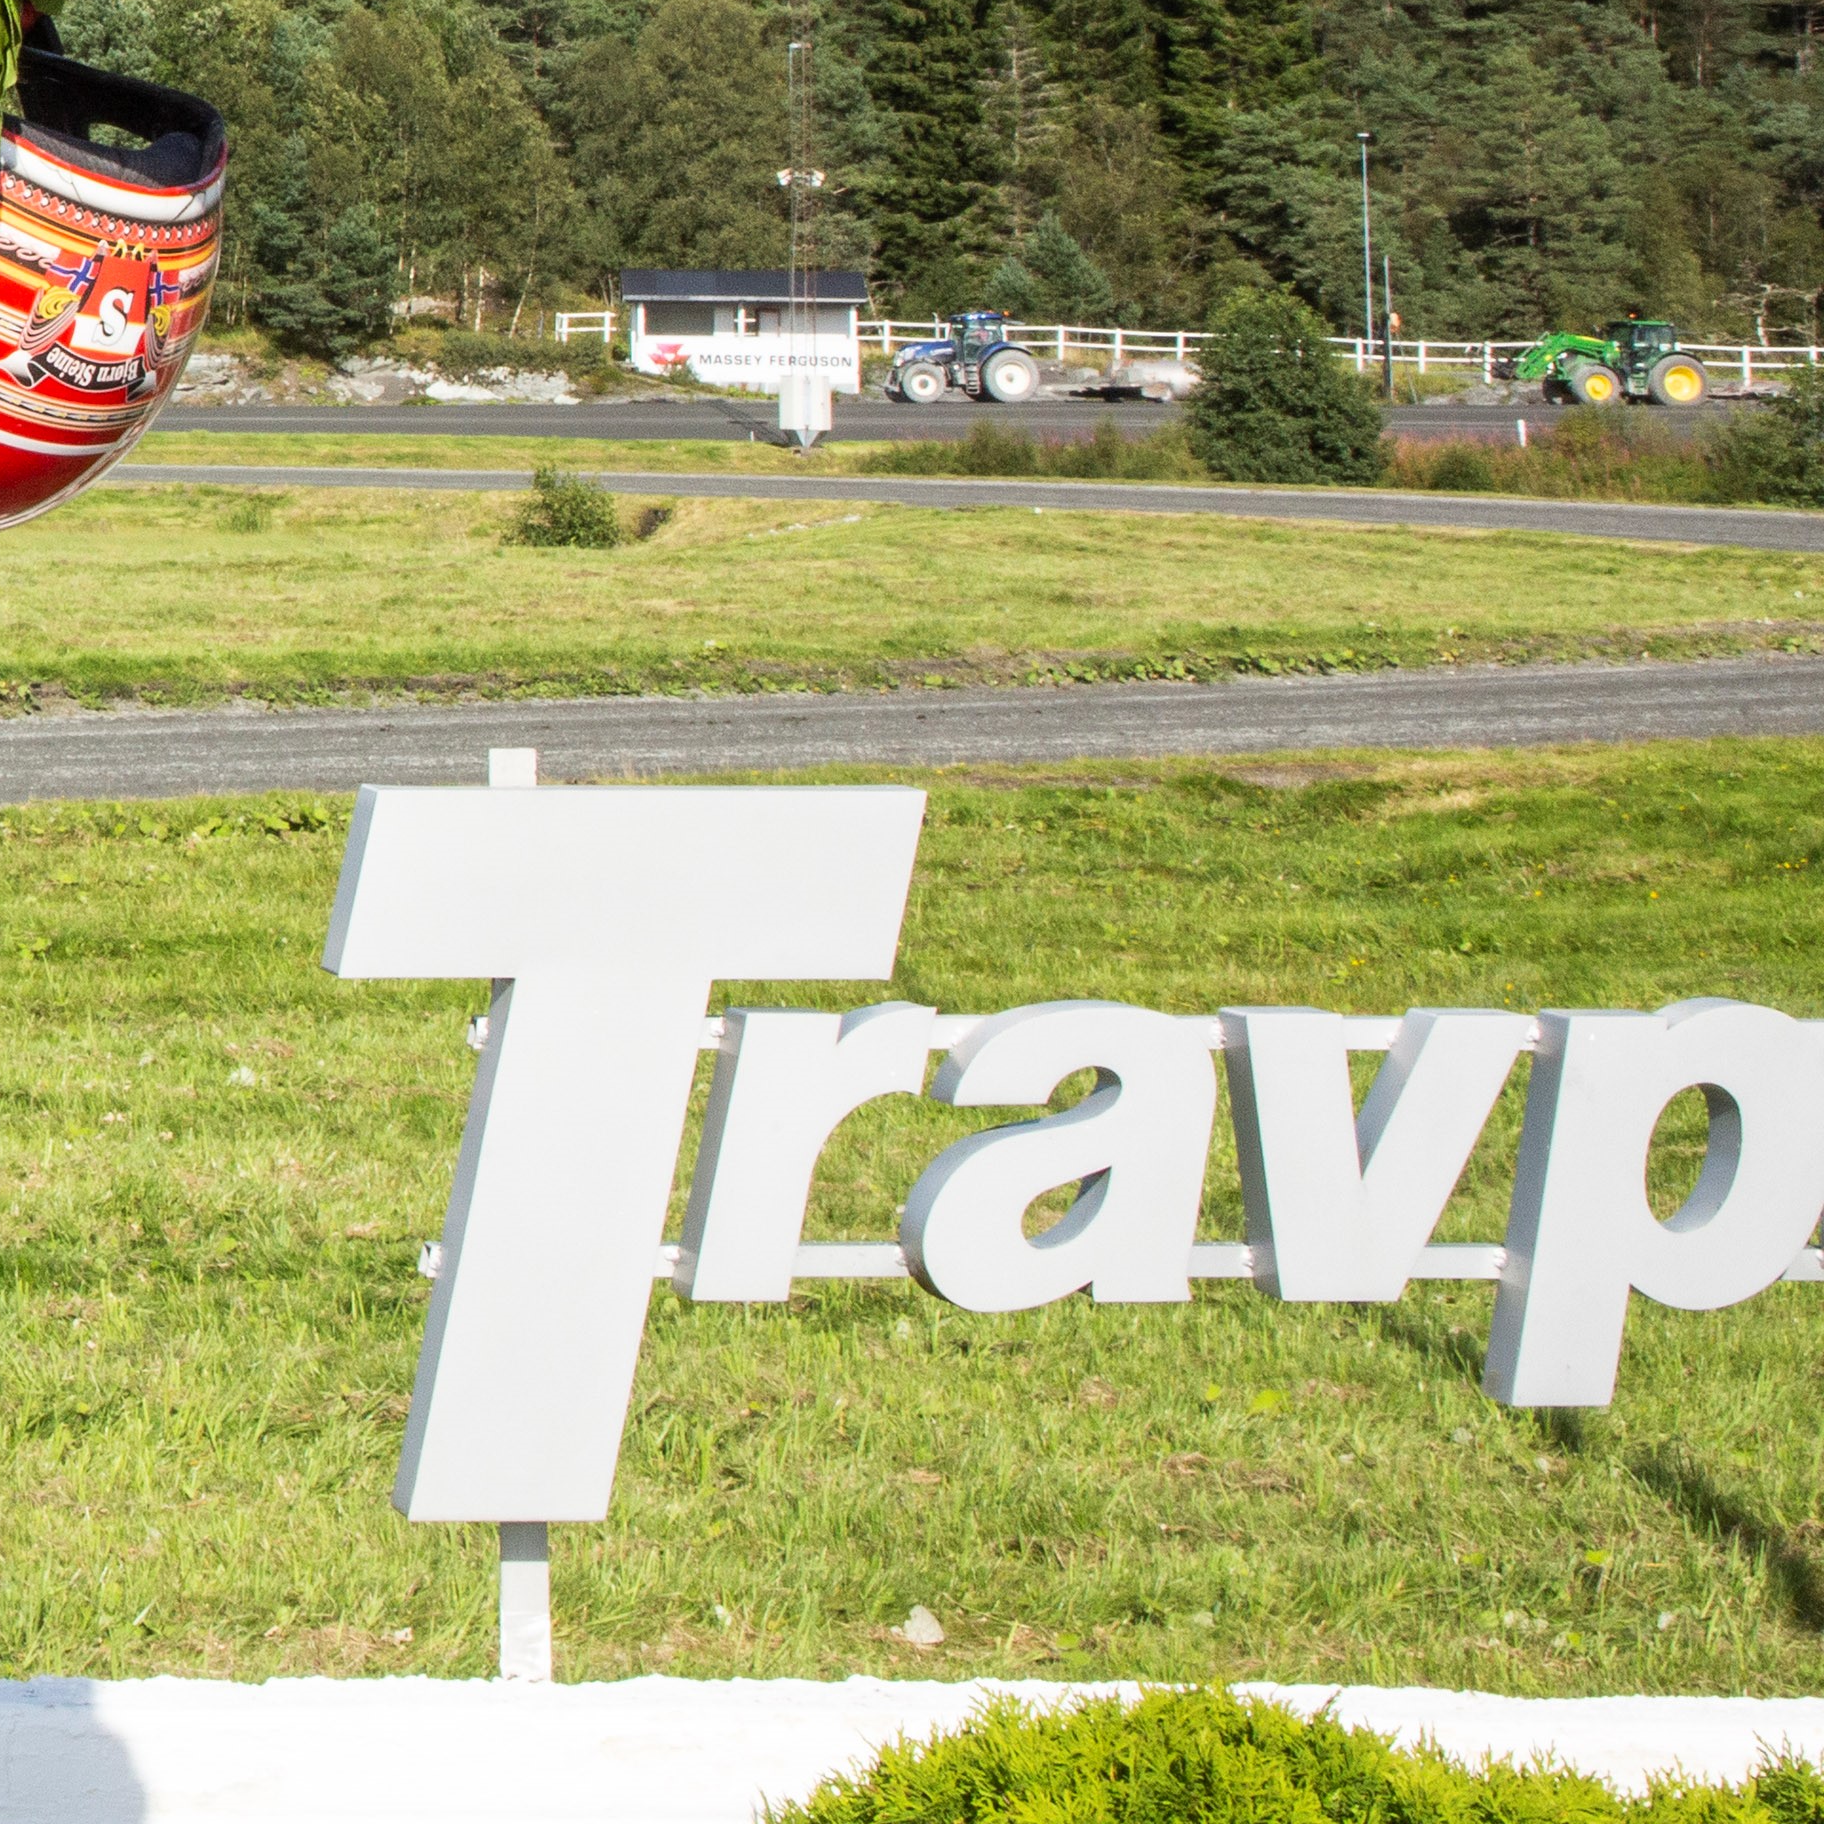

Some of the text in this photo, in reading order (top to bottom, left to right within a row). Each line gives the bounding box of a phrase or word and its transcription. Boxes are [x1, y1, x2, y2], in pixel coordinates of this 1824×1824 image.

[91, 286, 136, 347] S
[46, 346, 95, 386] Steine
[699, 354, 852, 367] MASSEY FERGUSON
